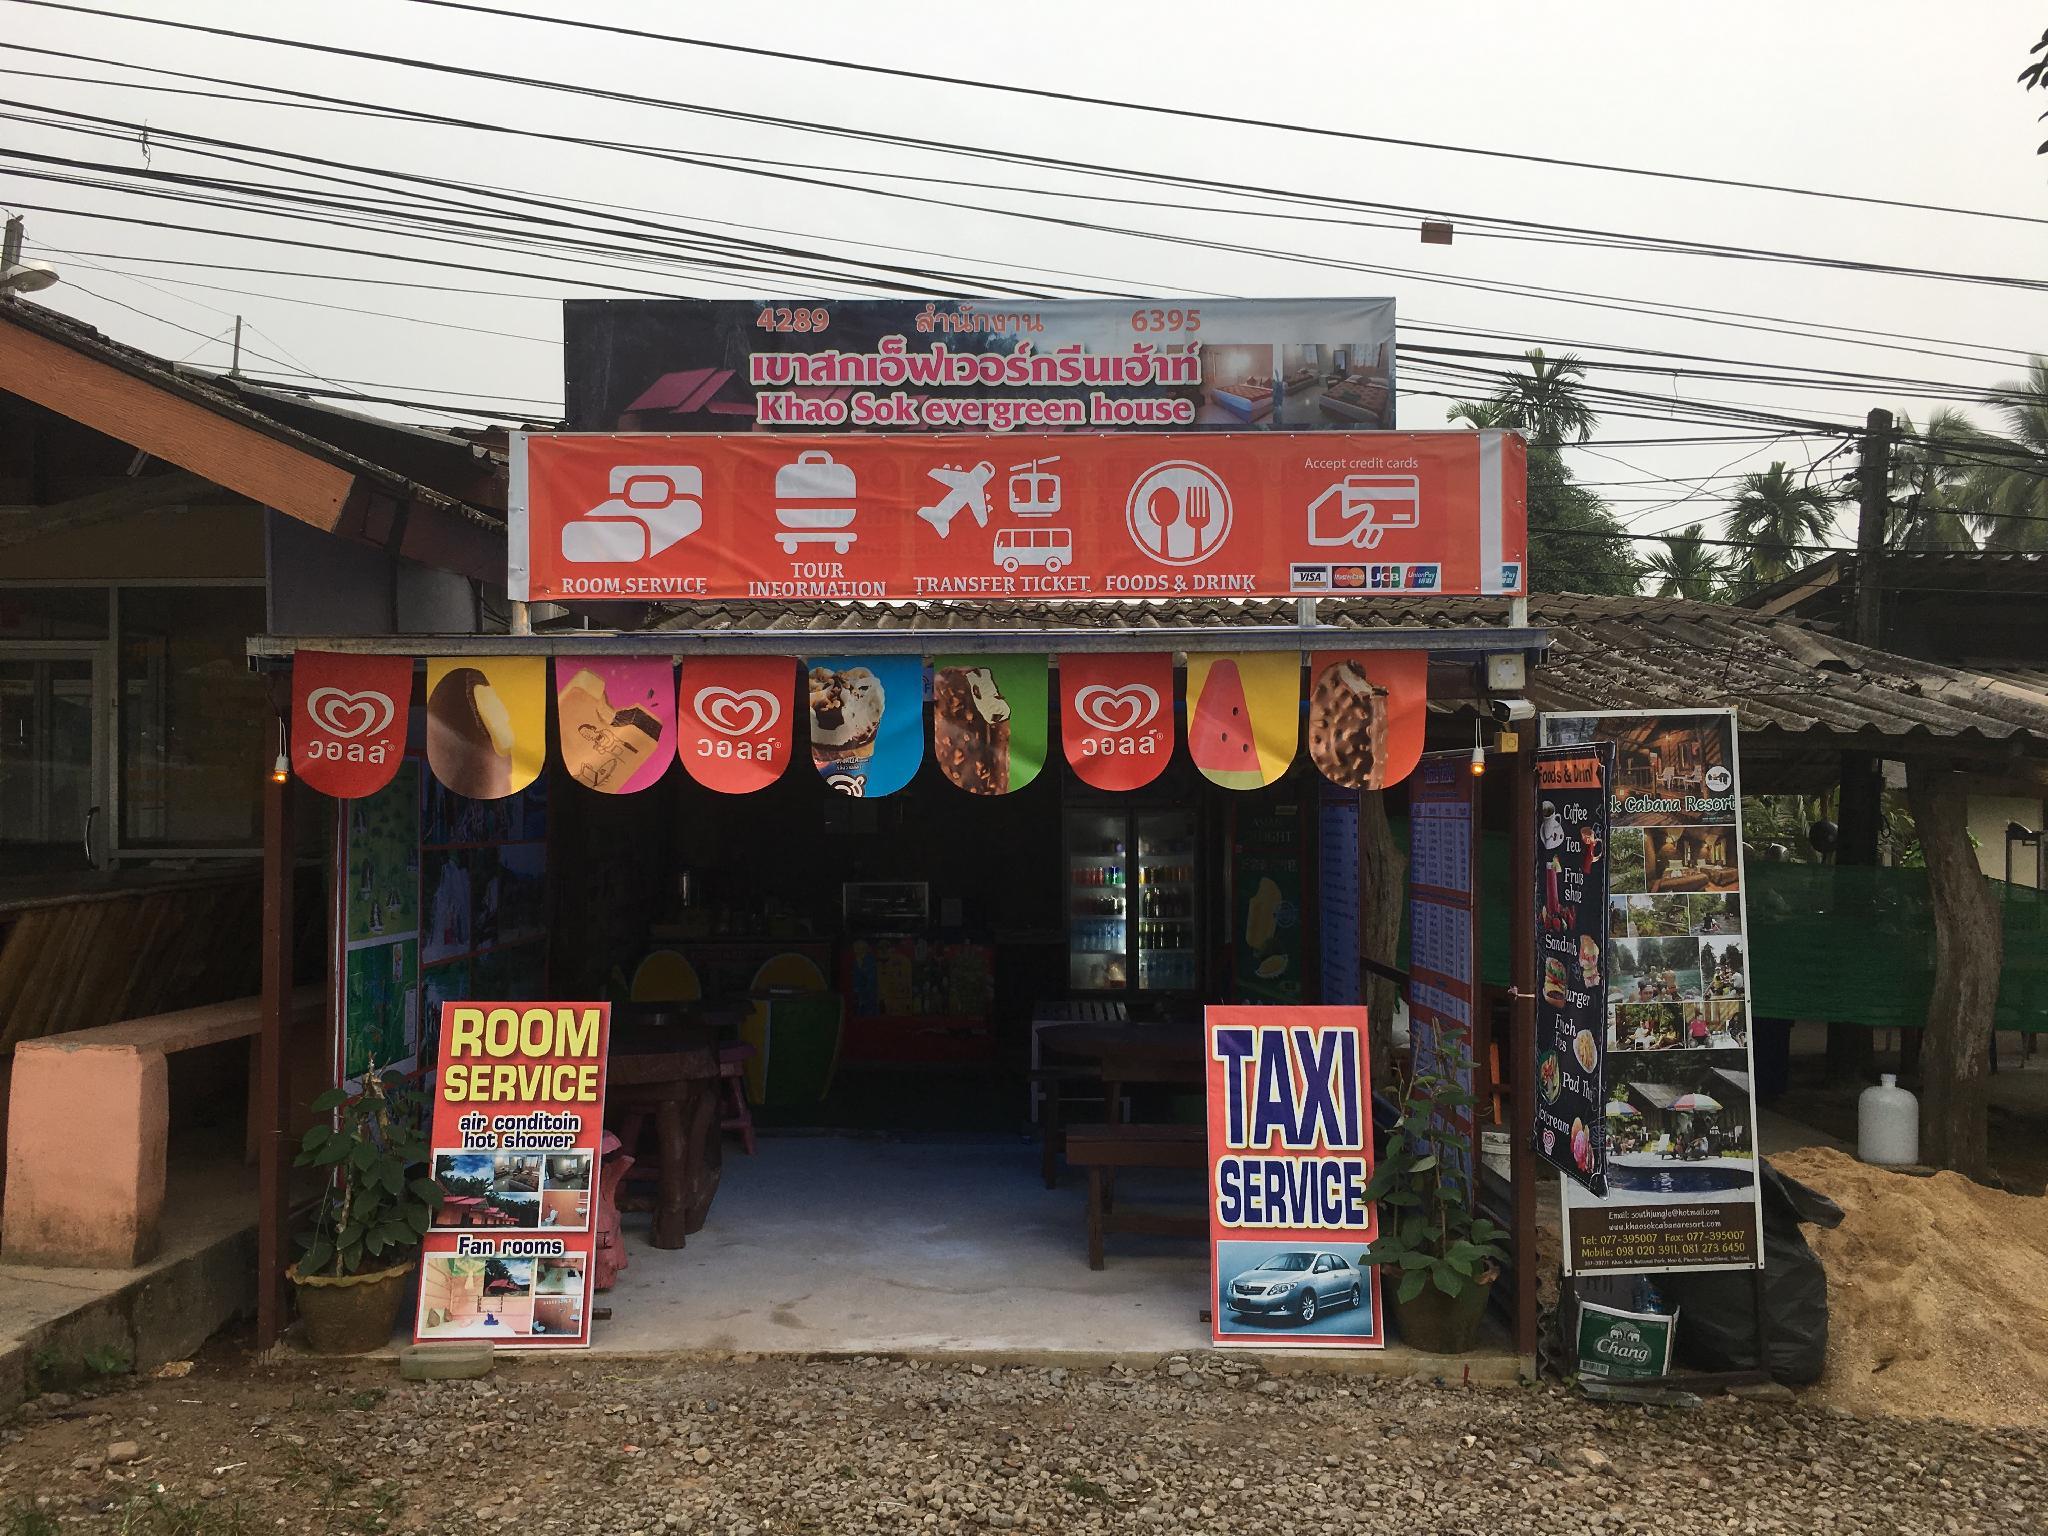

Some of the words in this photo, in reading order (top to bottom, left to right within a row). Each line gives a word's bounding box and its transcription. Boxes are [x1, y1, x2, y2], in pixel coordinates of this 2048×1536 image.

[756, 307, 830, 334] 4289
[915, 303, 1045, 334] สำนักงาน
[1131, 308, 1202, 333] 6395
[759, 393, 846, 423] Khao
[853, 393, 917, 423] Sok
[924, 399, 1083, 429] evergreen
[1093, 394, 1193, 422] house
[1304, 457, 1347, 471] Accept
[1349, 457, 1384, 470] credit
[1386, 457, 1419, 470] cards
[790, 562, 845, 578] TOUR
[1299, 572, 1322, 582] VISA
[1371, 572, 1400, 583] JCB
[561, 577, 622, 594] ROOM
[625, 577, 708, 594] SERVICE
[748, 581, 887, 598] INFORMATION
[912, 575, 1016, 593] TRANSFER
[1019, 575, 1091, 593] TICKET
[1105, 574, 1169, 592] FOODS
[1172, 575, 1188, 591] &
[1192, 574, 1257, 591] DRINK
[307, 739, 390, 764] วอลล์
[696, 737, 775, 762] วอลล์
[1081, 729, 1157, 757] วอลล์
[1563, 802, 1588, 824] Coffee
[1625, 794, 1682, 813] Cabana
[1685, 794, 1736, 812] Resort
[1565, 836, 1581, 852] Tea
[1565, 989, 1591, 1009] urger
[450, 1008, 600, 1058] ROOM
[443, 1064, 599, 1103] SERVICE
[1215, 1028, 1360, 1147] TAXI
[1562, 1071, 1580, 1094] Pad
[459, 1113, 488, 1131] air
[493, 1113, 580, 1131] conditoin
[463, 1131, 498, 1149] hot
[503, 1130, 574, 1149] shower
[1219, 1158, 1365, 1226] SERVICE
[458, 1236, 494, 1255] Fan
[501, 1238, 563, 1254] rooms
[1580, 1235, 1598, 1245] Tel:
[1600, 1233, 1658, 1245] 077-395007
[1665, 1233, 1684, 1242] Fax:
[1686, 1230, 1745, 1241] 077-395007
[1581, 1246, 1614, 1258] Mobile:
[1616, 1246, 1634, 1256] 098
[1637, 1245, 1655, 1255] 020
[1682, 1243, 1699, 1254] 081
[1701, 1243, 1719, 1253] 273
[1722, 1242, 1745, 1253] 6450
[1596, 1338, 1649, 1362] Chang
